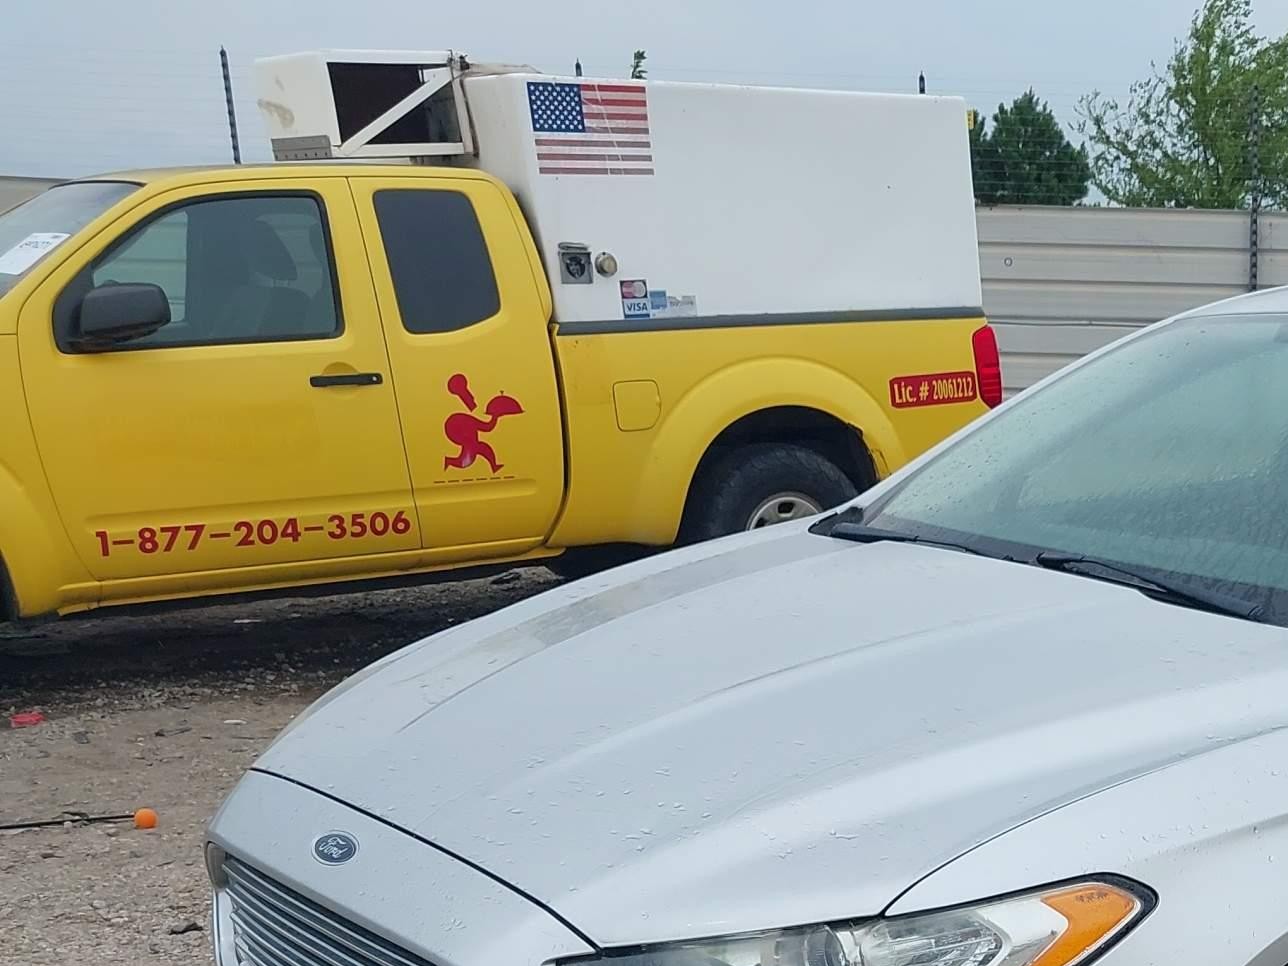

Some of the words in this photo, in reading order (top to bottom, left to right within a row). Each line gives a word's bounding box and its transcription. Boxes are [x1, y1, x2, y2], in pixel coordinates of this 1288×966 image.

[626, 302, 649, 312] VISA
[893, 381, 917, 404] Lic.
[918, 381, 930, 401] #
[931, 377, 974, 401] 20061212
[95, 510, 412, 558] 1-877-204-3506
[318, 836, 349, 859] Ford
